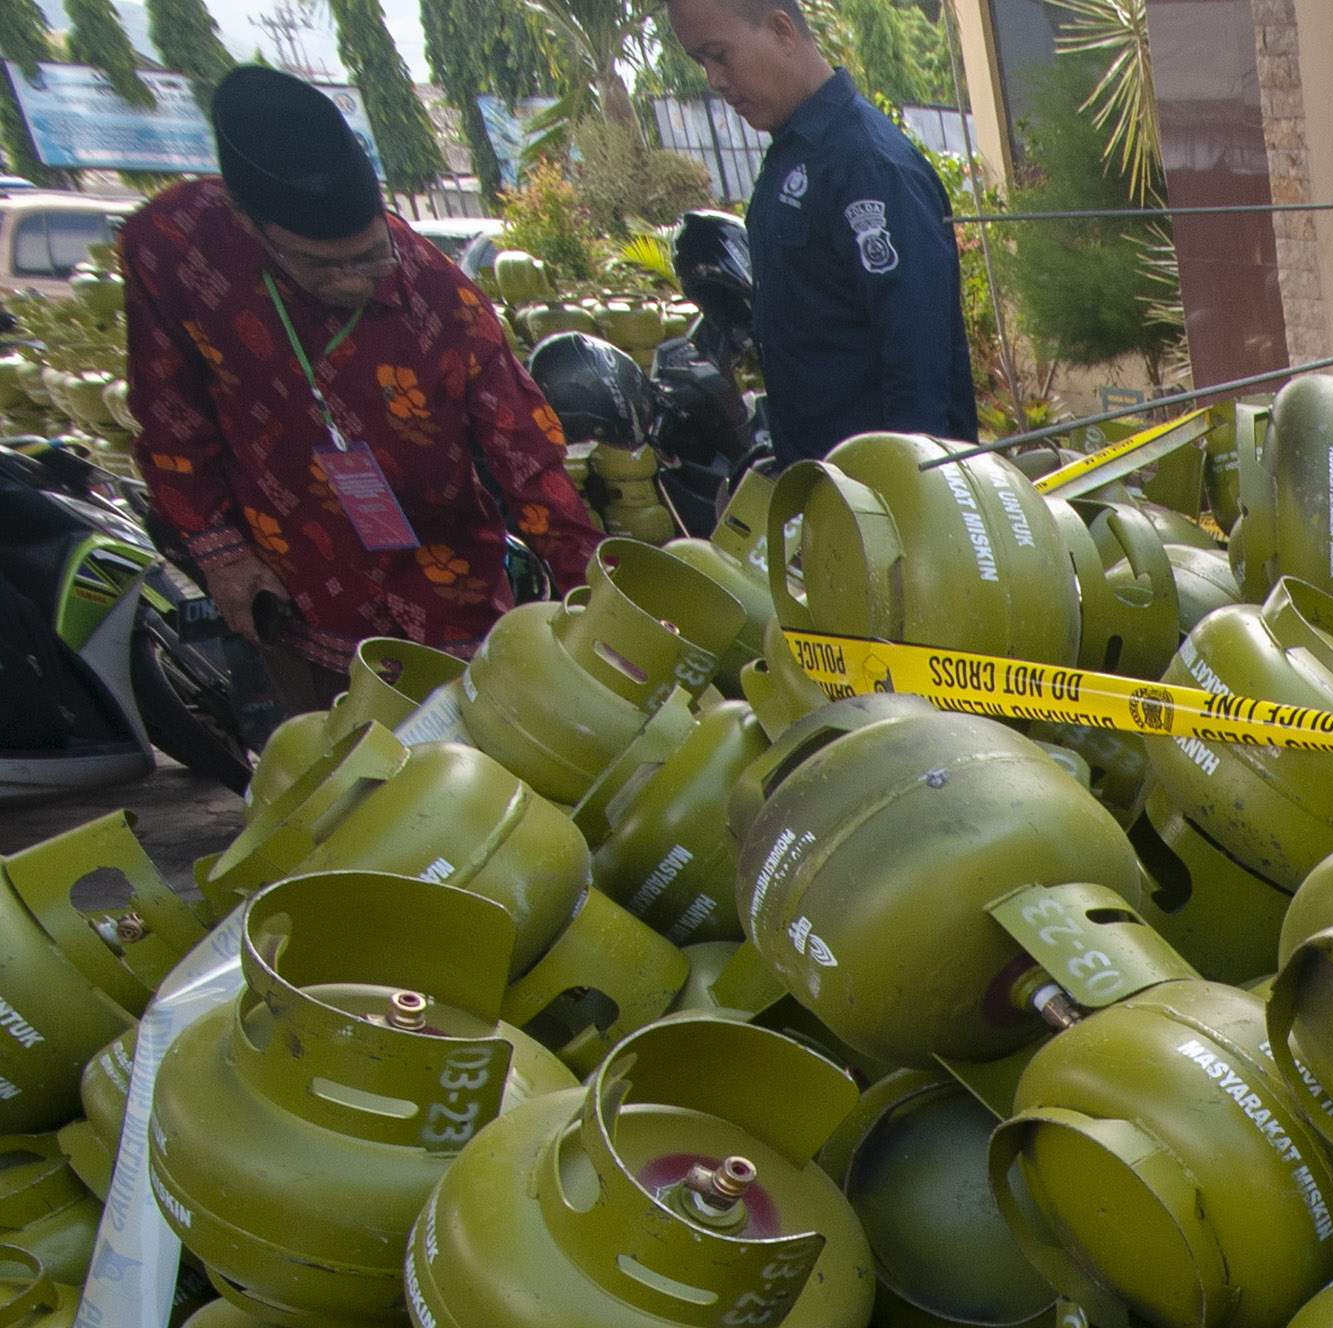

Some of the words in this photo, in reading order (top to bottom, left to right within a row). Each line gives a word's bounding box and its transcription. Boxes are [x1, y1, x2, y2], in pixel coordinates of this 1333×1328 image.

[997, 490, 1036, 549] UNTUK
[961, 510, 999, 583] MISKIN
[929, 654, 997, 693] CROSS
[1002, 662, 1046, 696] NOT
[1050, 670, 1083, 703] DO
[1199, 692, 1263, 722] LINE
[1020, 897, 1124, 1001] 03-23
[0, 1003, 46, 1050] NTUK
[420, 1045, 493, 1147] 03-23
[1175, 1038, 1300, 1165] MASYARAKAT
